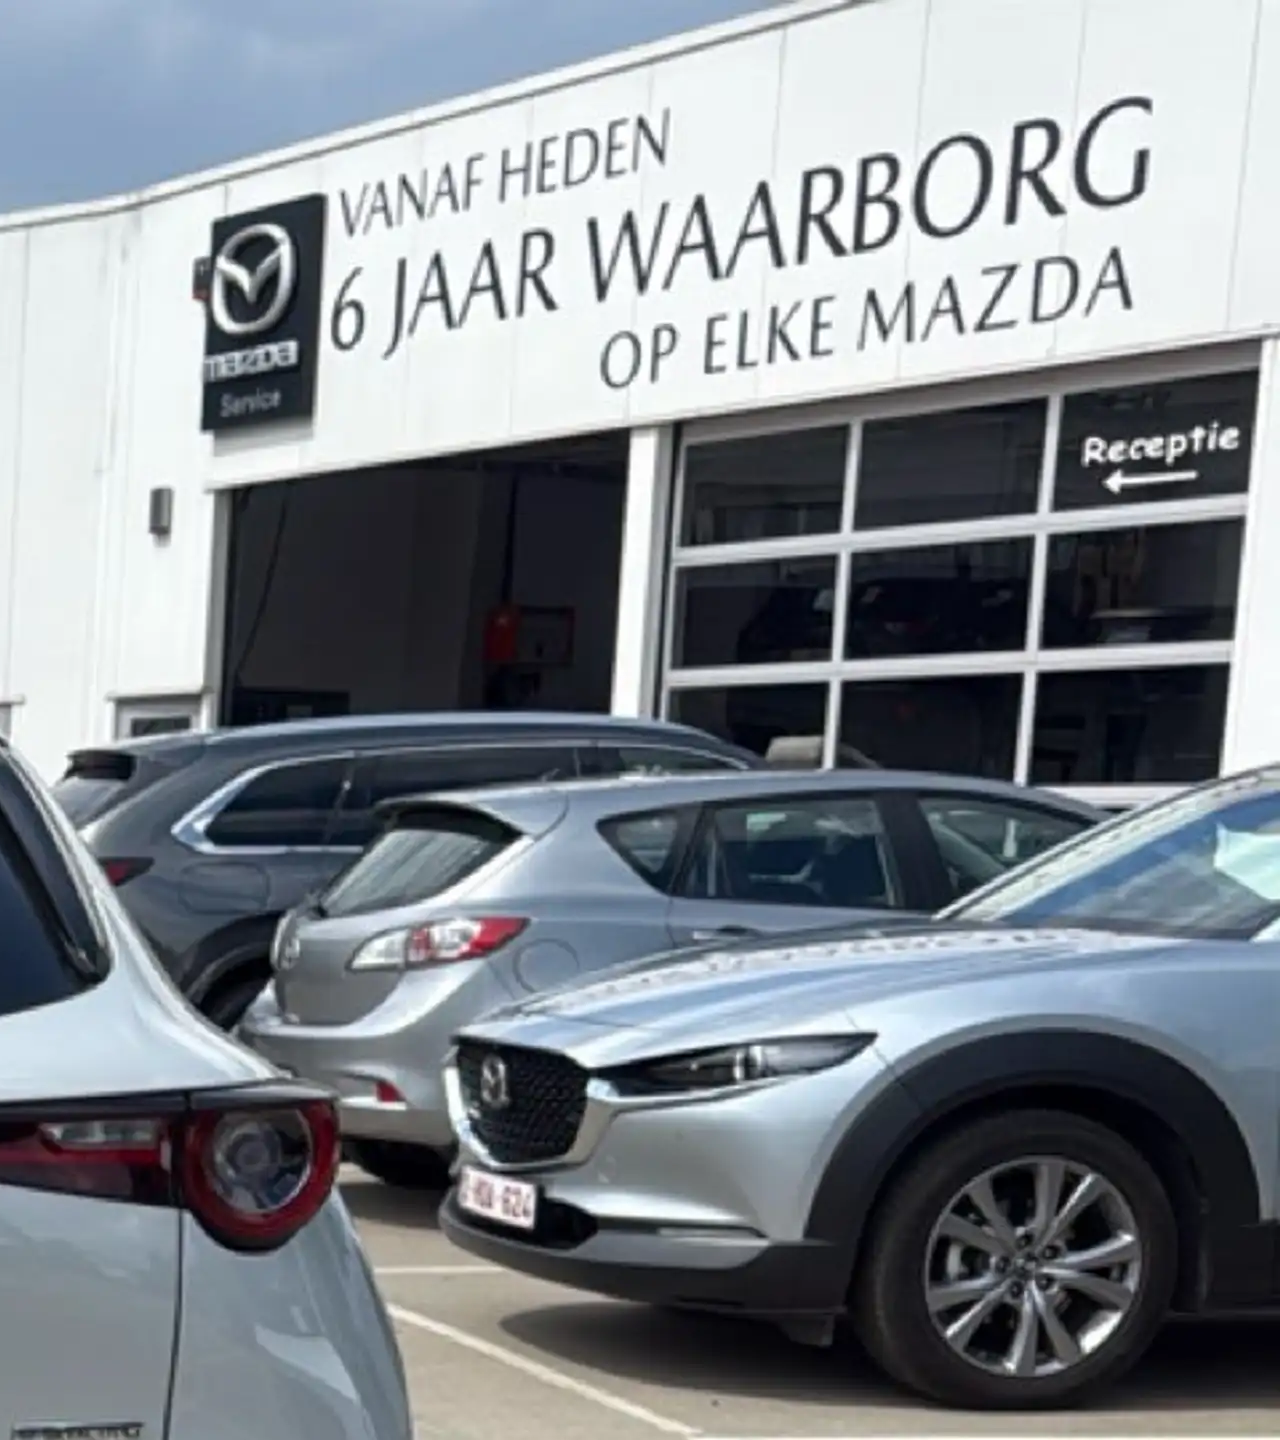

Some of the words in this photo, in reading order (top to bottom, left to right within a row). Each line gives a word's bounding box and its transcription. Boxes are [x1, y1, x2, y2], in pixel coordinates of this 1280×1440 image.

[330, 265, 365, 352] 6
[382, 226, 558, 360] JAAR
[586, 96, 1154, 303] WAARBORG
[339, 152, 487, 237] VANAF
[498, 107, 672, 203] HEDEN
[599, 322, 680, 388] OP
[703, 295, 837, 375] ELKE
[856, 246, 1134, 352] MAZDA
[1081, 420, 1240, 468] Receptie
